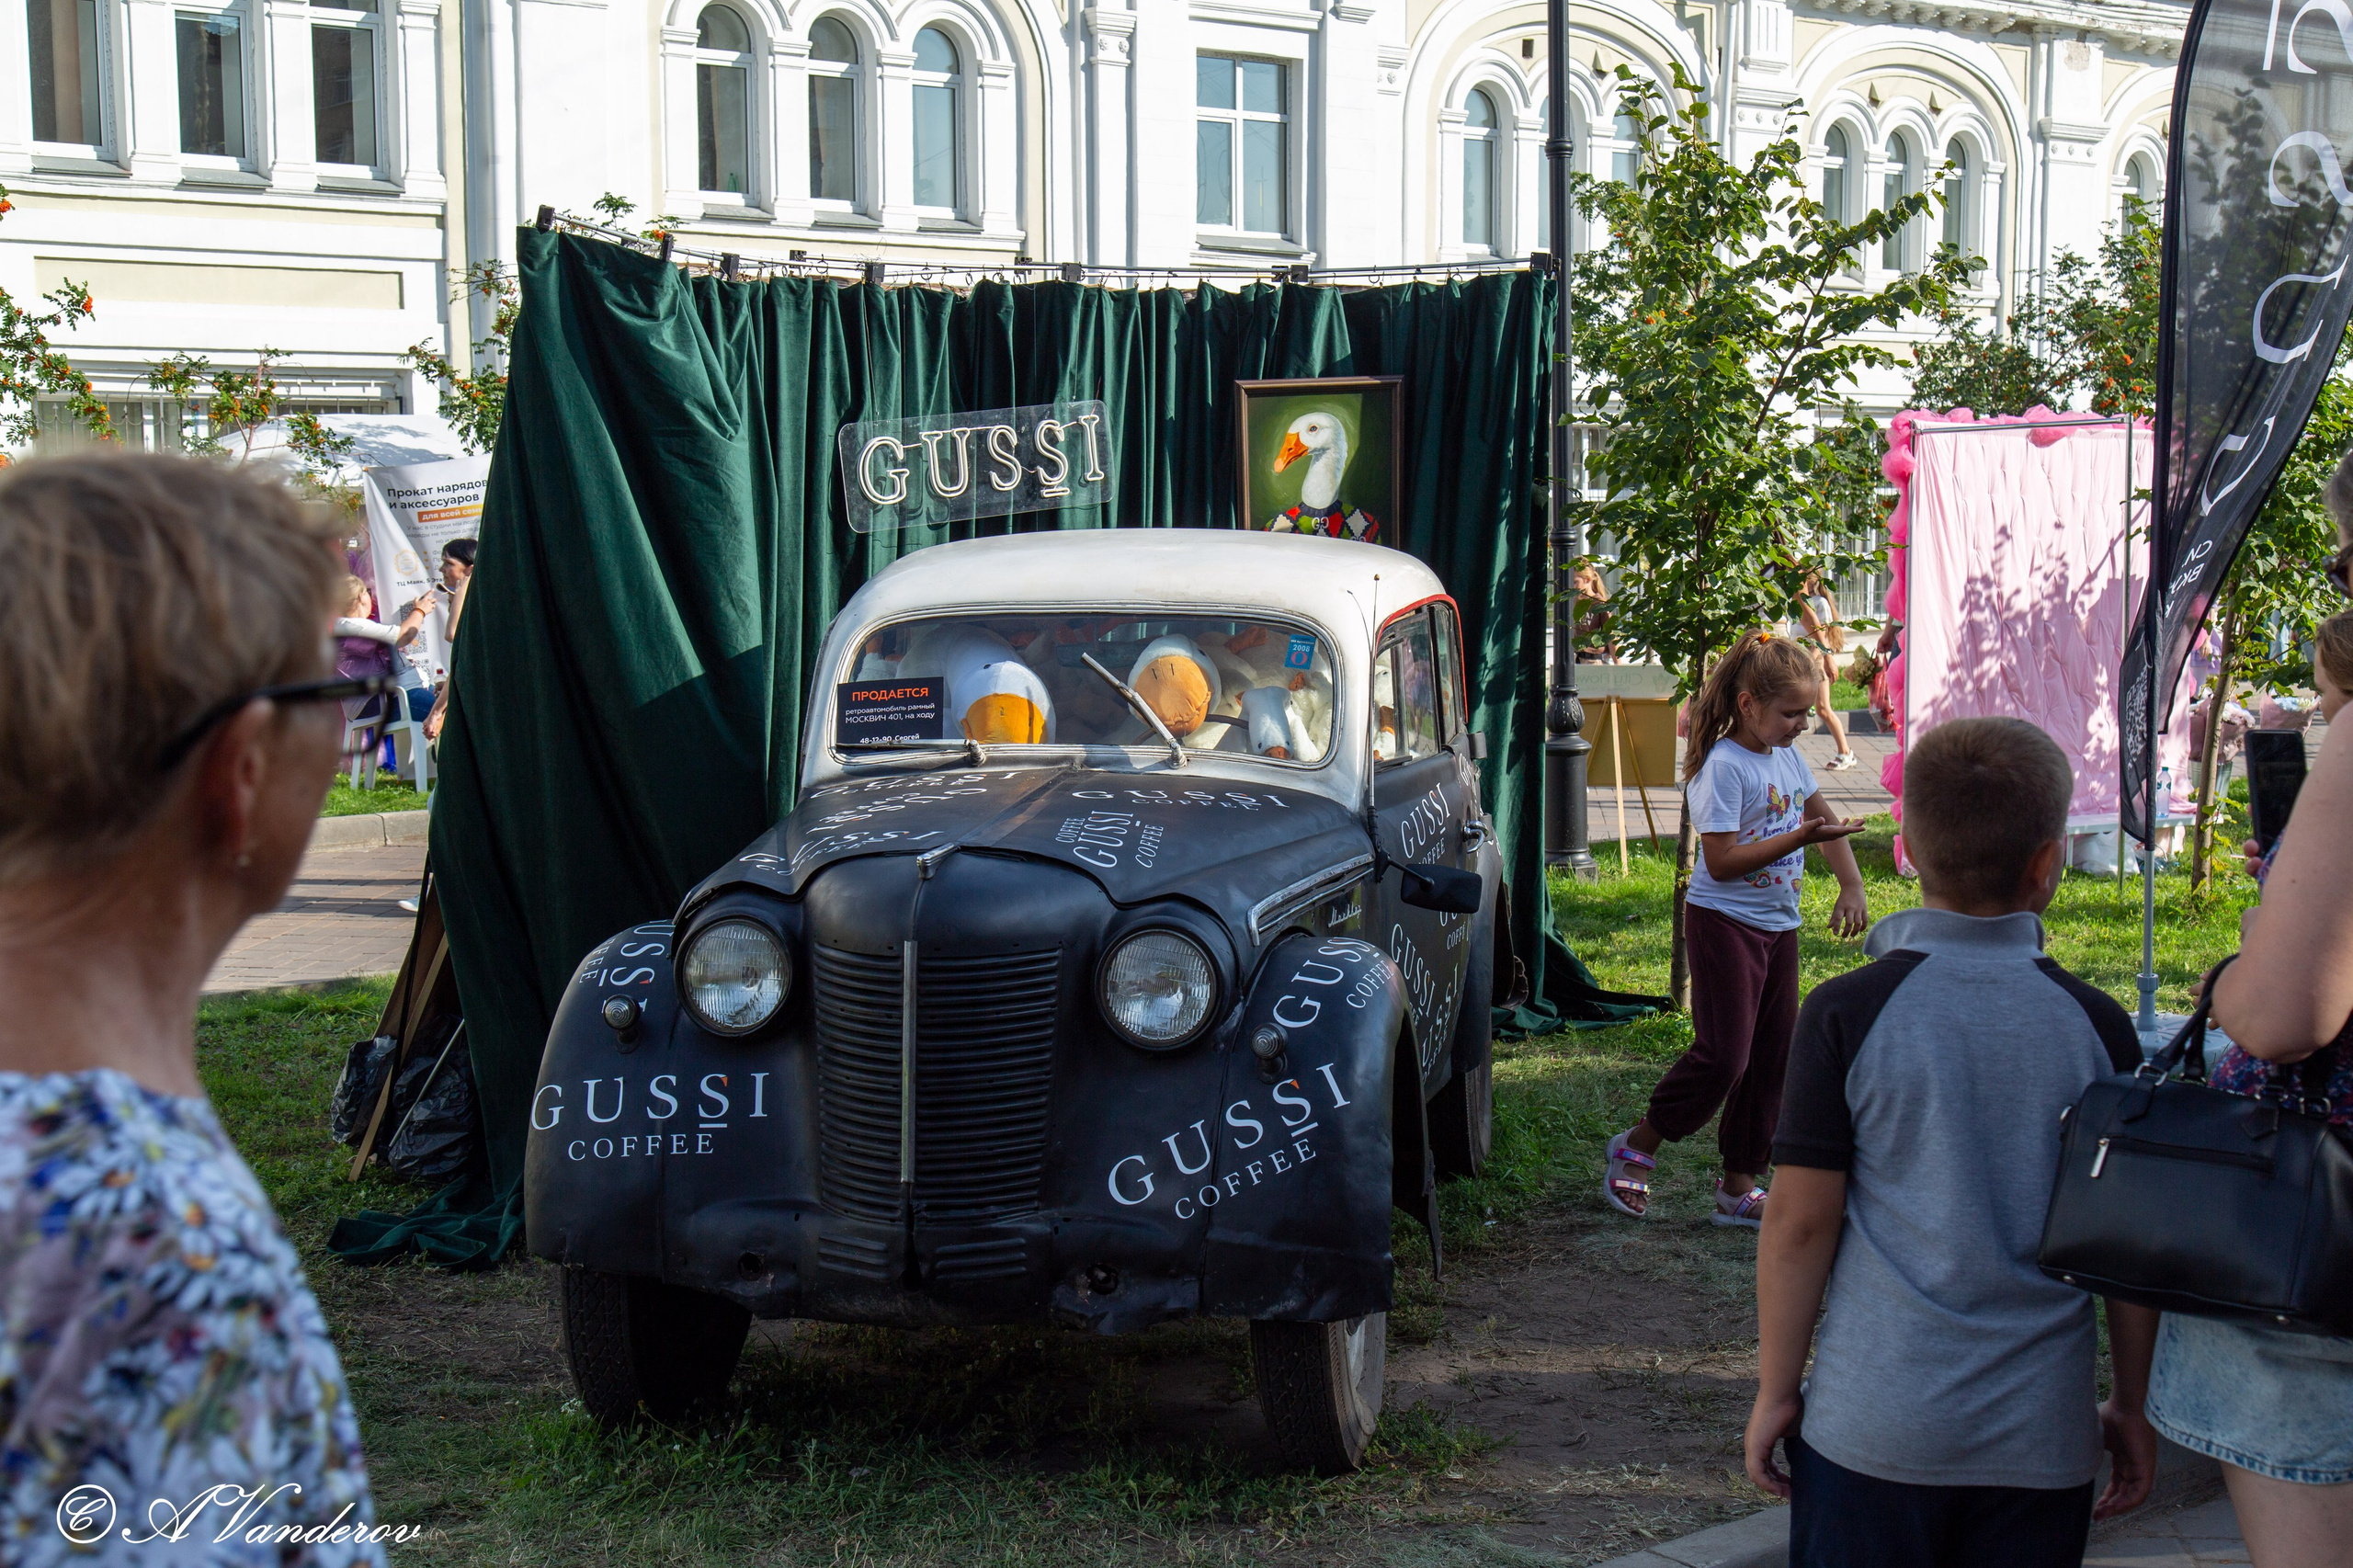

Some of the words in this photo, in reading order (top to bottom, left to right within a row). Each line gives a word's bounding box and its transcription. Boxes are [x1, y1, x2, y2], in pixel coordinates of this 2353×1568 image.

[858, 415, 1105, 505] GUSSI
[387, 487, 434, 499] Прокат
[437, 479, 487, 494] нарядов
[400, 494, 480, 509] аксессуаров
[422, 513, 438, 521] для
[440, 509, 461, 518] всей
[462, 506, 482, 516] семь
[1292, 643, 1311, 653] 2008
[852, 687, 929, 701] ПРОДАЕТСЯ
[846, 704, 907, 715] ретроавтомобиль
[907, 702, 936, 710] рамный
[846, 715, 887, 723] МОСКВИЧ
[888, 712, 904, 722] 401,
[916, 711, 936, 720] ходу
[1072, 790, 1290, 809] GUSSI
[1131, 799, 1259, 812] COFFEE
[1055, 817, 1086, 844] COFFEE
[1400, 782, 1450, 858] GUSSI
[1073, 810, 1141, 868] GUSSI
[1134, 824, 1165, 869] COFFEE
[1417, 837, 1446, 865] OFFEE
[1273, 937, 1379, 1028] GUSSI
[1347, 960, 1394, 1008] COFFEE
[1392, 924, 1435, 1017] GUSSI
[1422, 962, 1459, 1067] USSI
[531, 1072, 770, 1130] GUSSI
[567, 1133, 714, 1161] COFFEE
[1108, 1062, 1351, 1206] GUSSI
[1175, 1138, 1317, 1220] COFFEE
